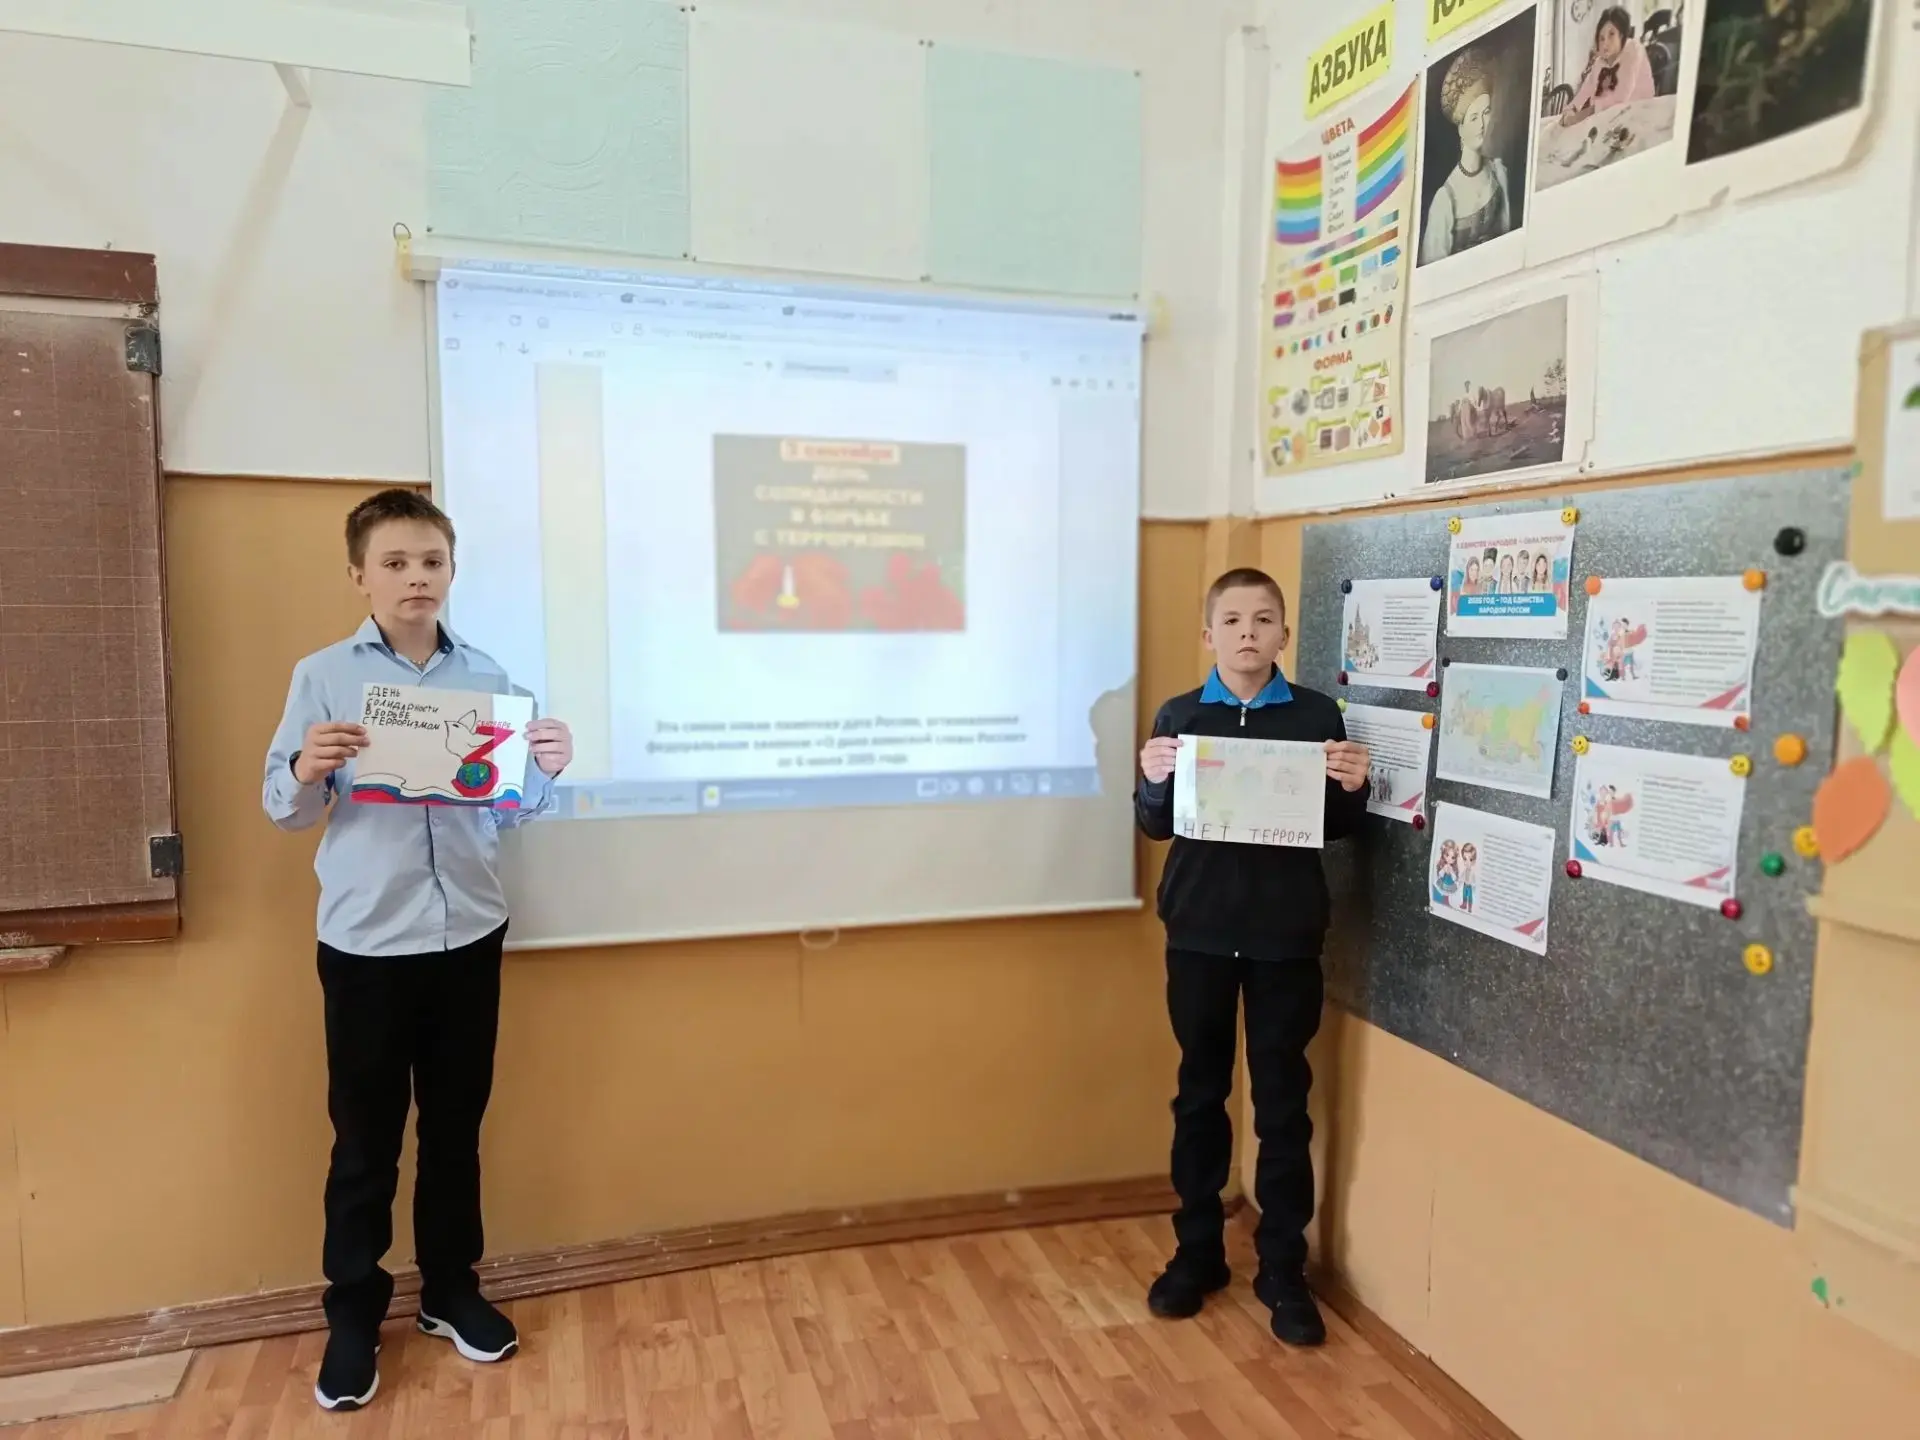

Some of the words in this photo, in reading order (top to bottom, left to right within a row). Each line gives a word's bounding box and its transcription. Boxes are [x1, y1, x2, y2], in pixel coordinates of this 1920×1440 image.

[1309, 19, 1387, 103] АЗБУКА
[1321, 117, 1355, 145] ЦВЕТА
[1314, 350, 1352, 370] ФОРМА
[368, 685, 400, 697] ДЕНЬ
[1184, 822, 1231, 840] НЕТ
[1249, 828, 1312, 844] ТЕРРОРУ
